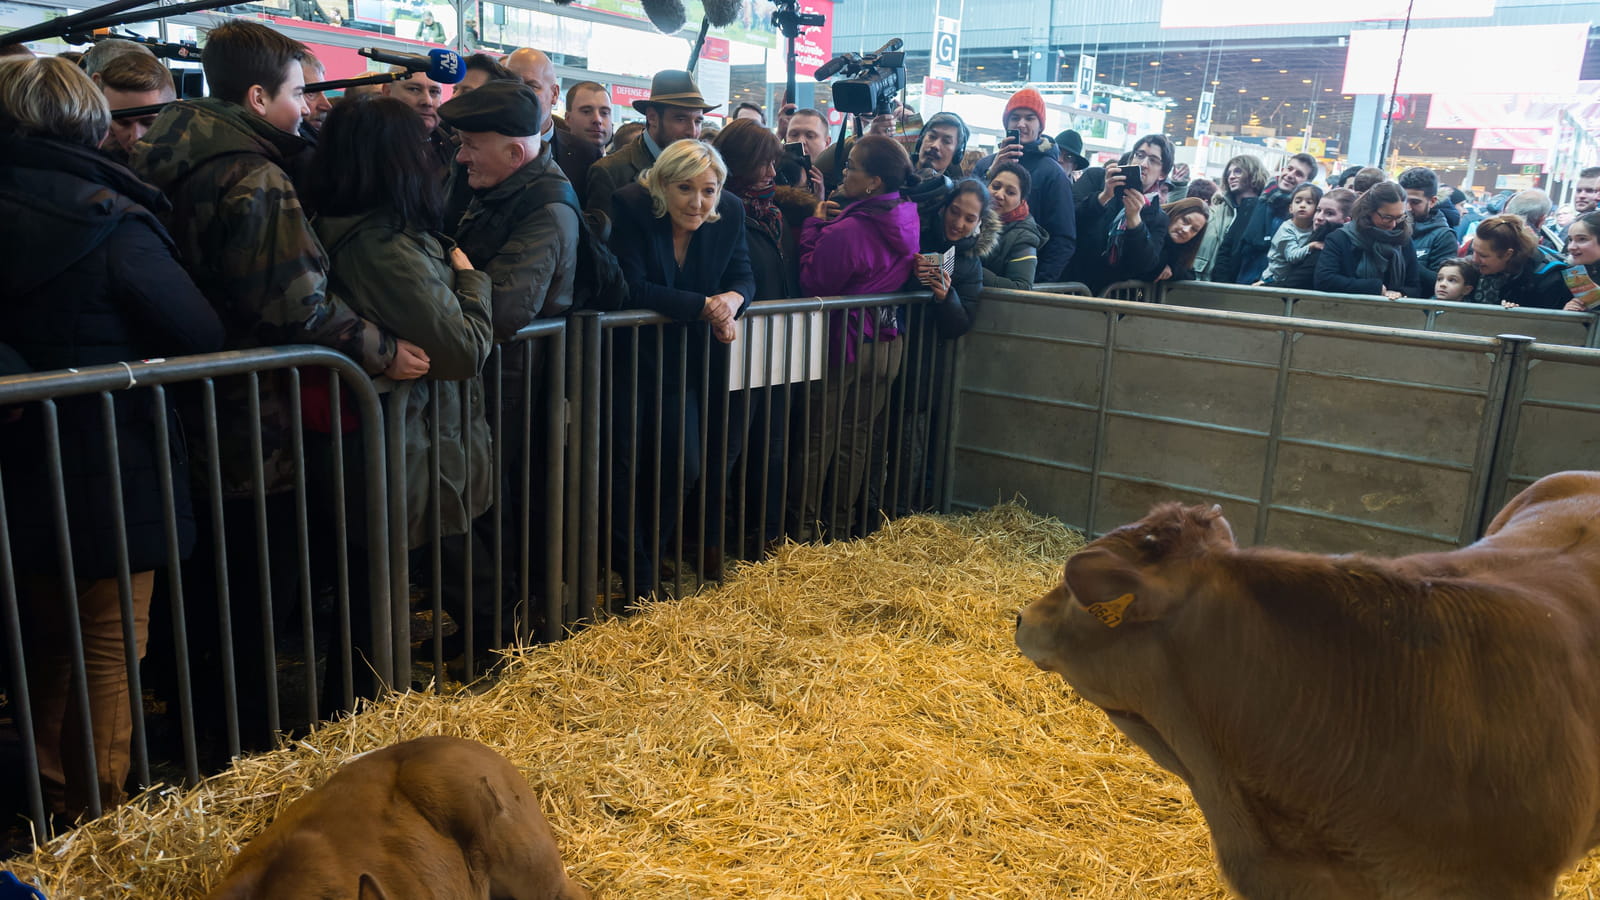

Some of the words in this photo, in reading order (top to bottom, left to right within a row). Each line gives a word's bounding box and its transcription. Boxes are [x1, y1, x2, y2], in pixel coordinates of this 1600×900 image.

[939, 34, 953, 62] G
[449, 52, 459, 75] BFM
[1082, 68, 1092, 91] H
[616, 86, 642, 97] DEFENSE
[1201, 103, 1210, 120] J
